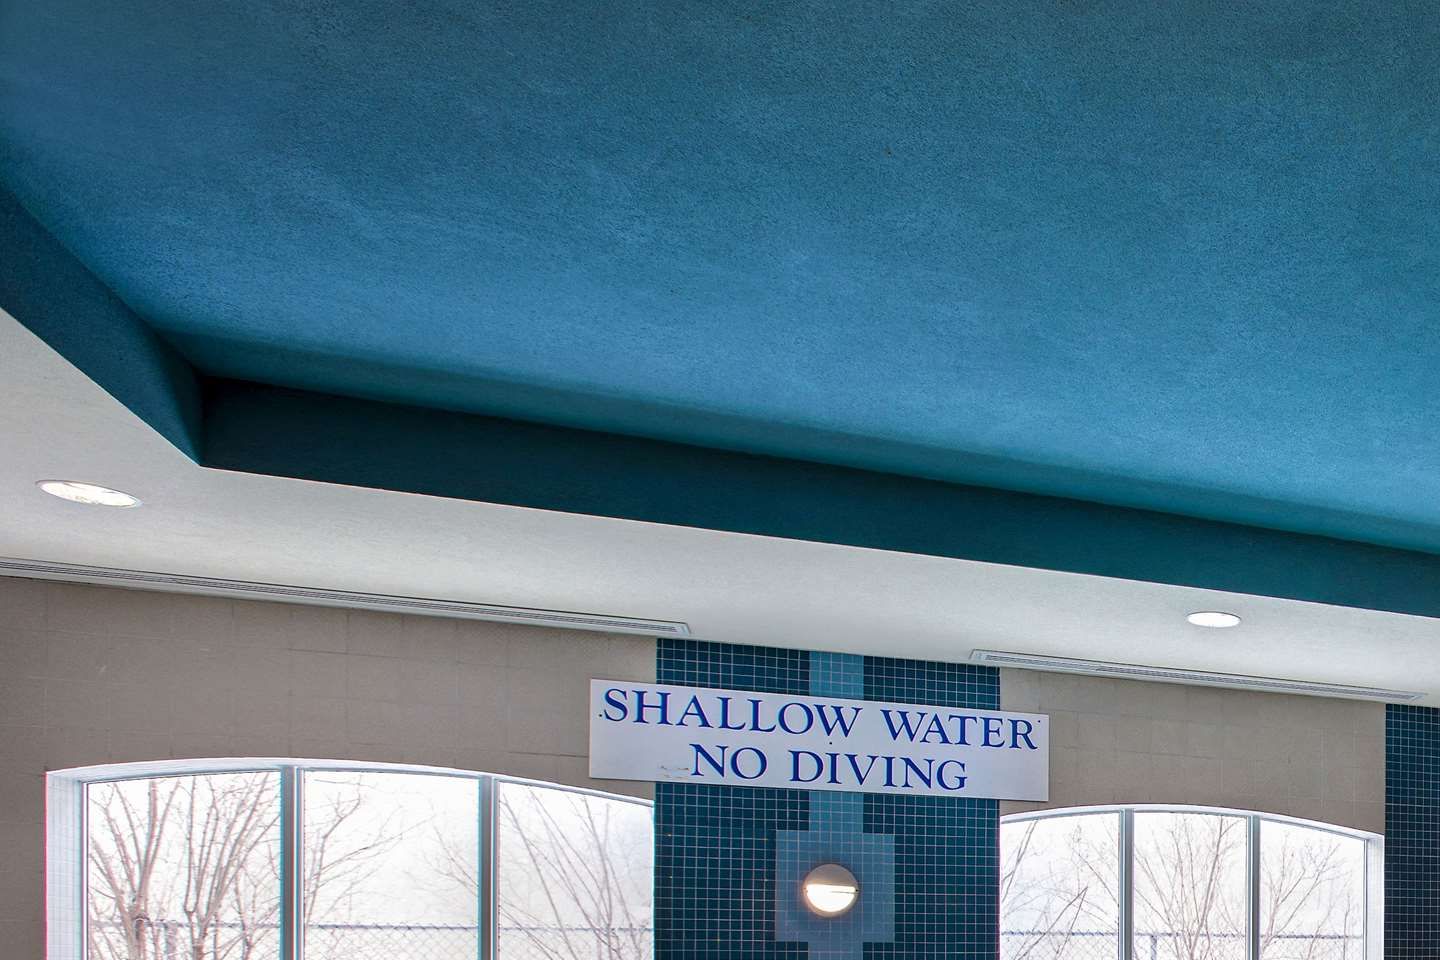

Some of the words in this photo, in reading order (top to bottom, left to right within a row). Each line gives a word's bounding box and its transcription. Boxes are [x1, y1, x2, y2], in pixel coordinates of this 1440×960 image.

[603, 687, 862, 738] SHALLOW
[880, 709, 1038, 751] WATER
[689, 743, 768, 780] NO
[788, 750, 968, 791] DIVING
